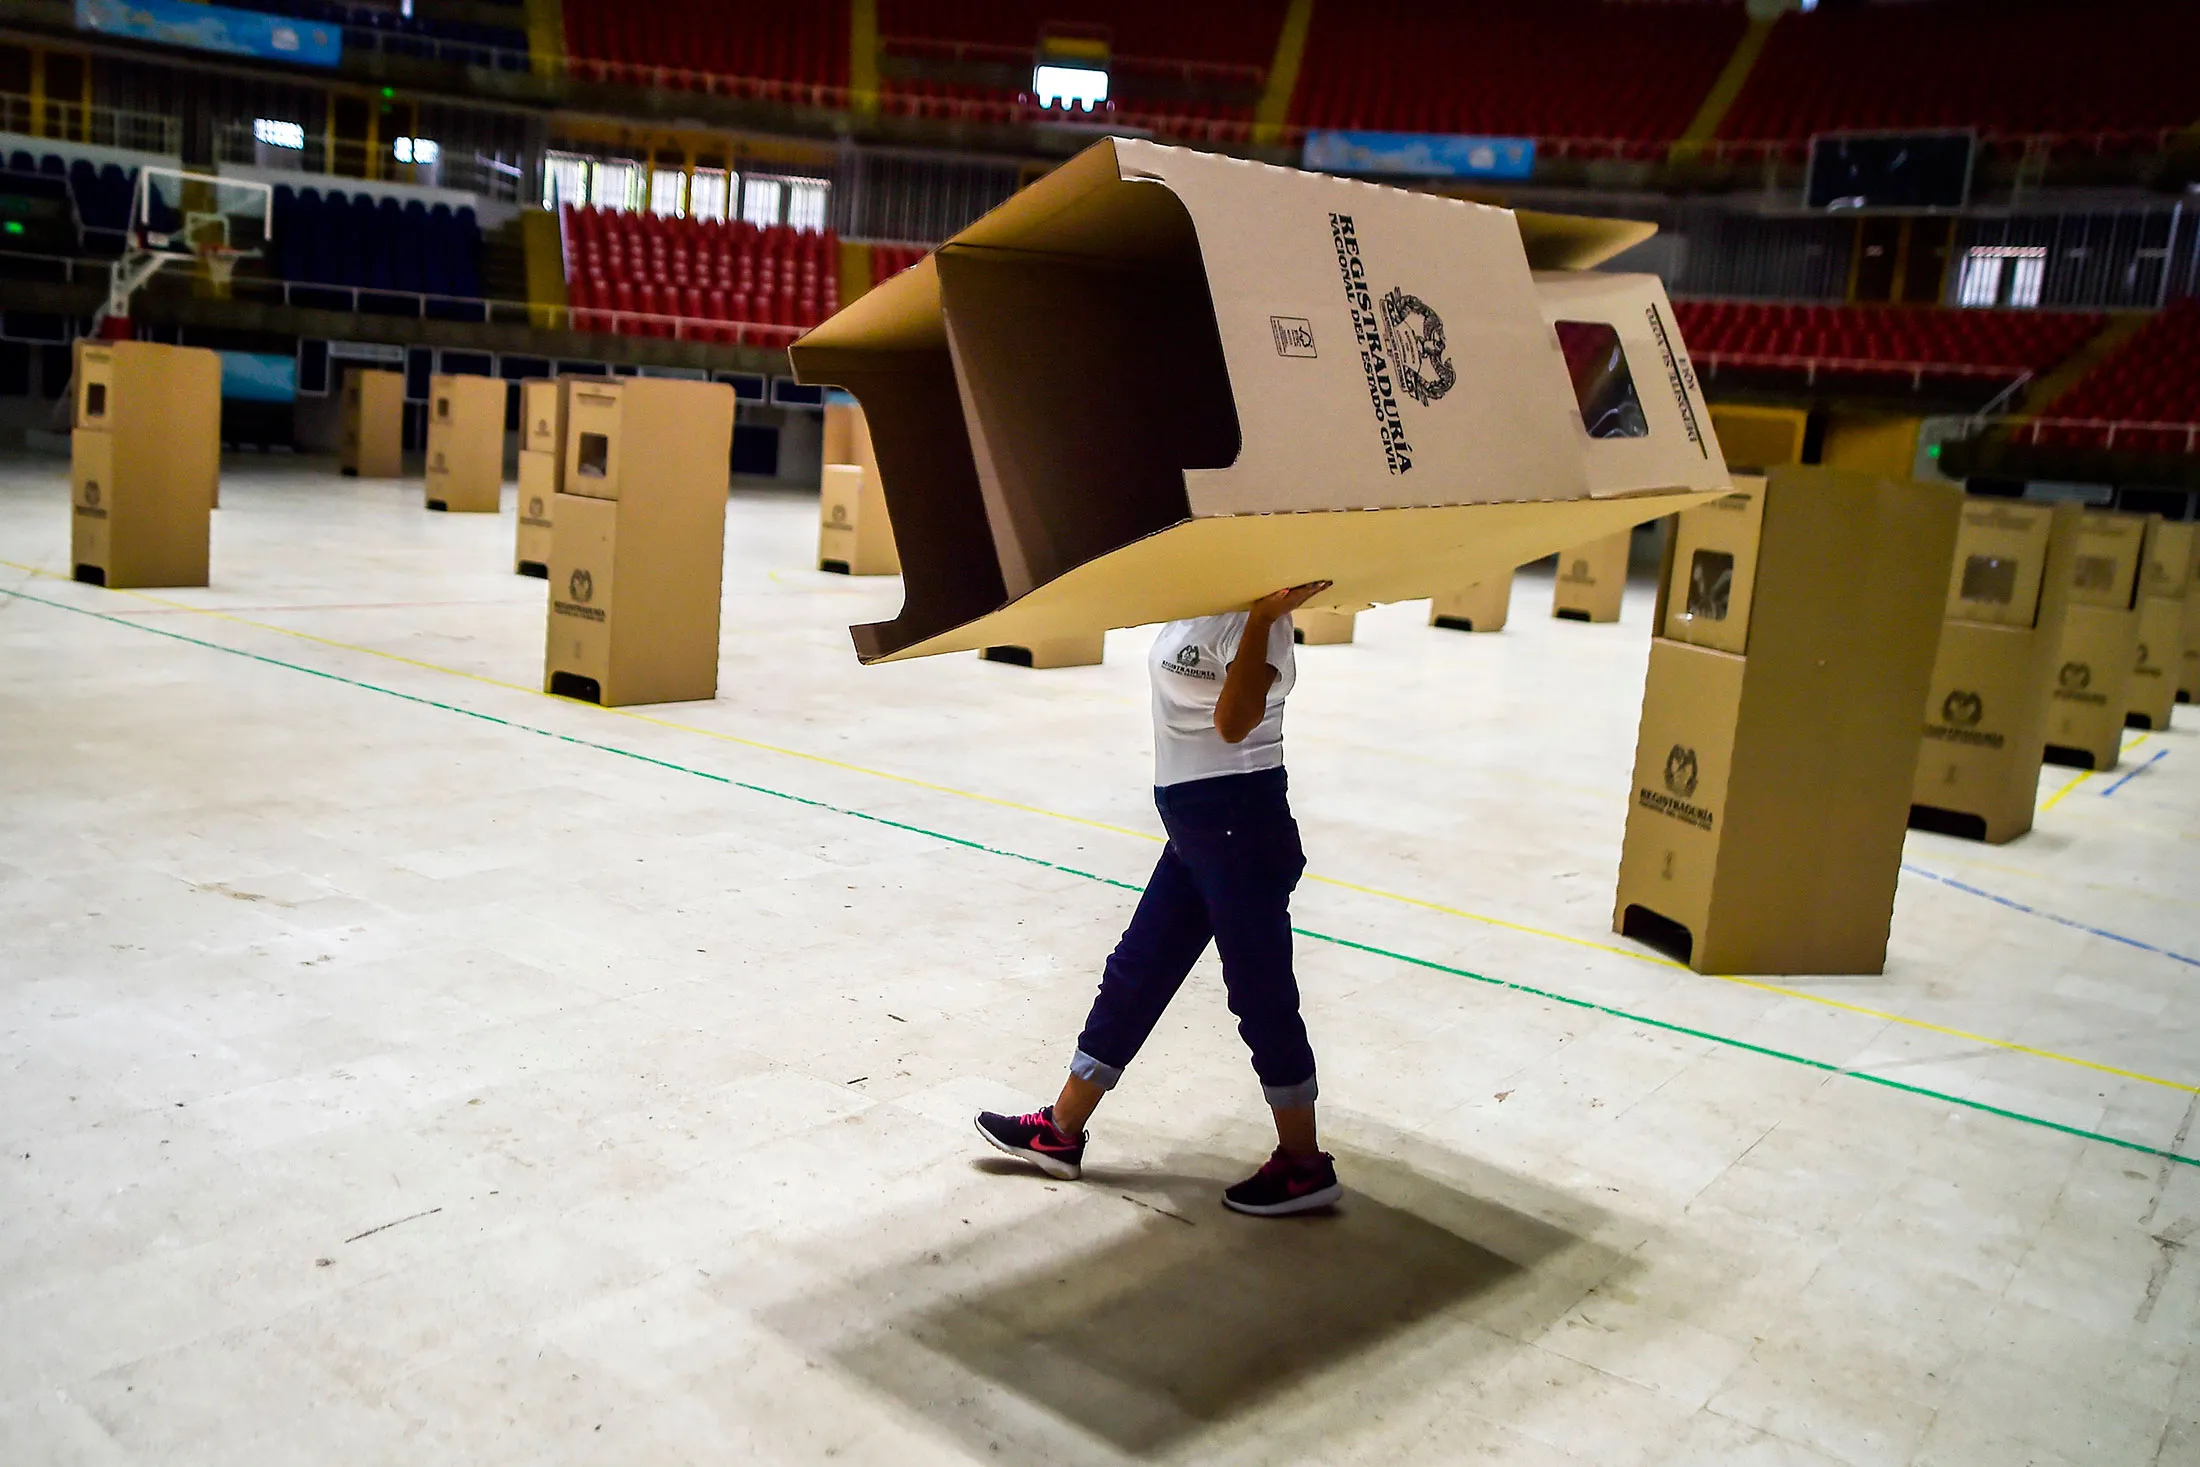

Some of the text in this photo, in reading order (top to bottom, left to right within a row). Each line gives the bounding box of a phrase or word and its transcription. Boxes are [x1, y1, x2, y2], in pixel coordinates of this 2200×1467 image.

[1328, 212, 1396, 475] NACIONAL DEL ESTADO CIVIL
[1338, 214, 1413, 475] REGISTRADURÍA
